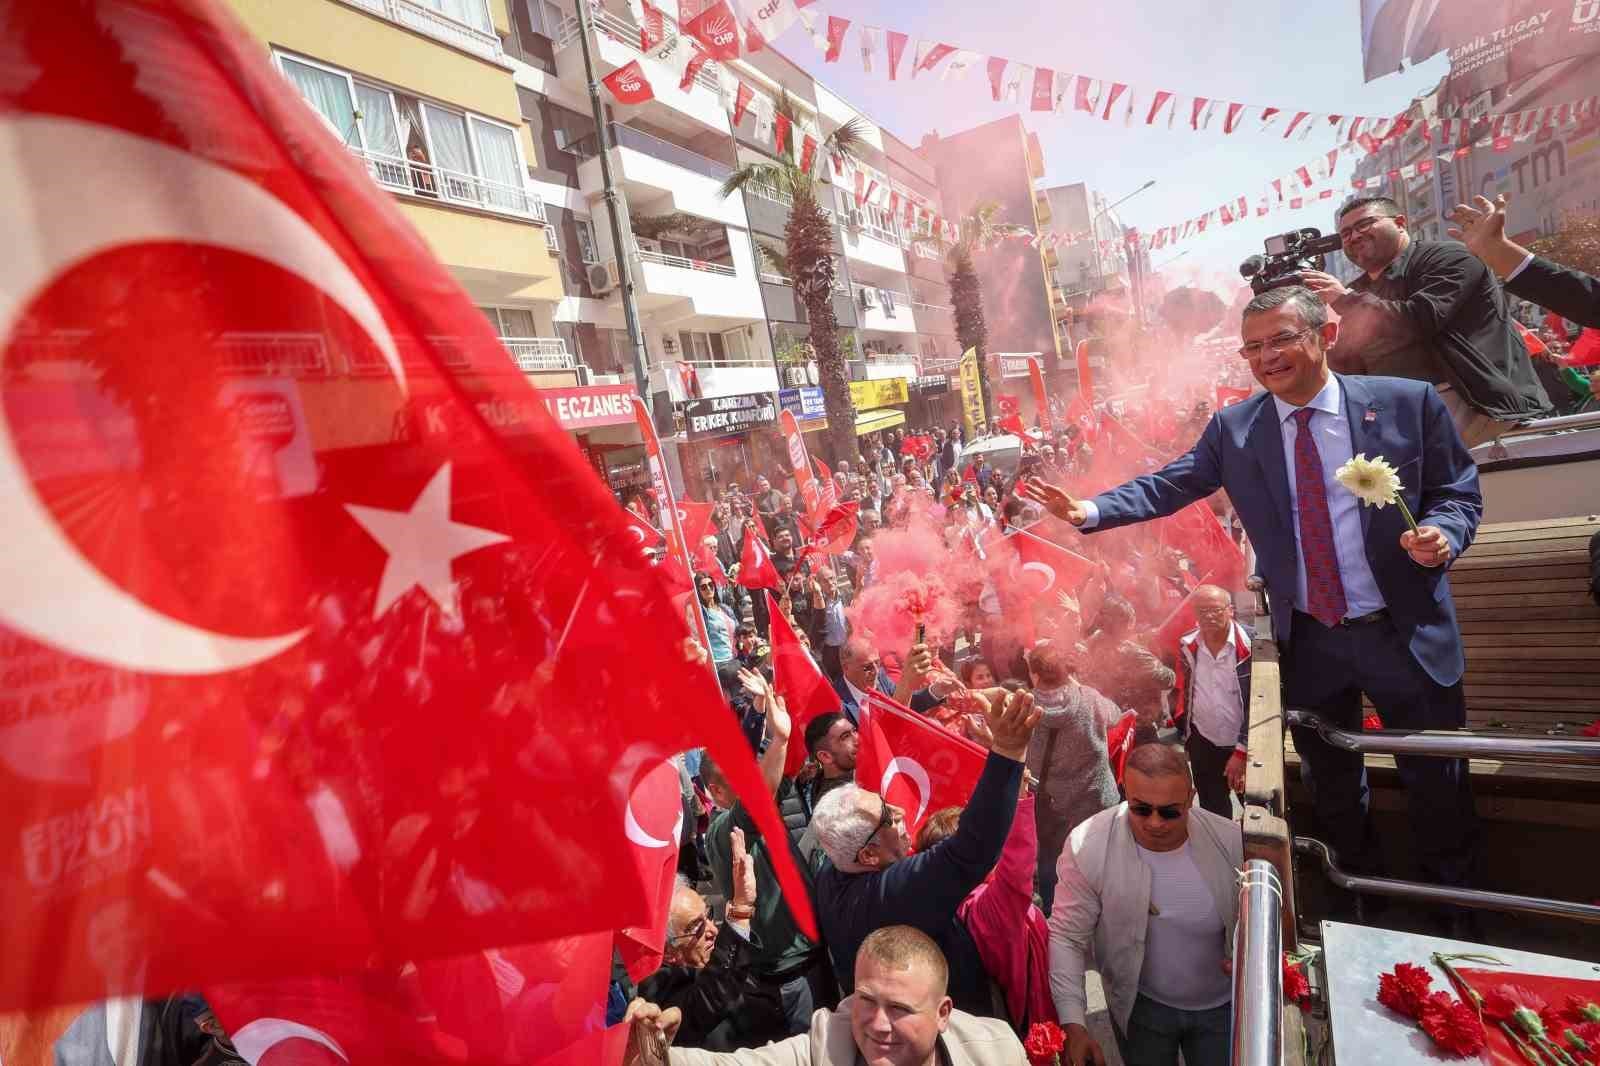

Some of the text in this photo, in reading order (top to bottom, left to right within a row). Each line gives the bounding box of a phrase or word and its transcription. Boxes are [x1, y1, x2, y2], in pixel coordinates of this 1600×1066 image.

[757, 0, 782, 21] CHP
[713, 32, 735, 47] CHP
[1450, 35, 1489, 61] EMİL
[1491, 8, 1553, 43] TUGAY
[620, 80, 642, 92] CHP
[556, 393, 635, 421] ECZANES
[692, 411, 731, 433] ERKEK
